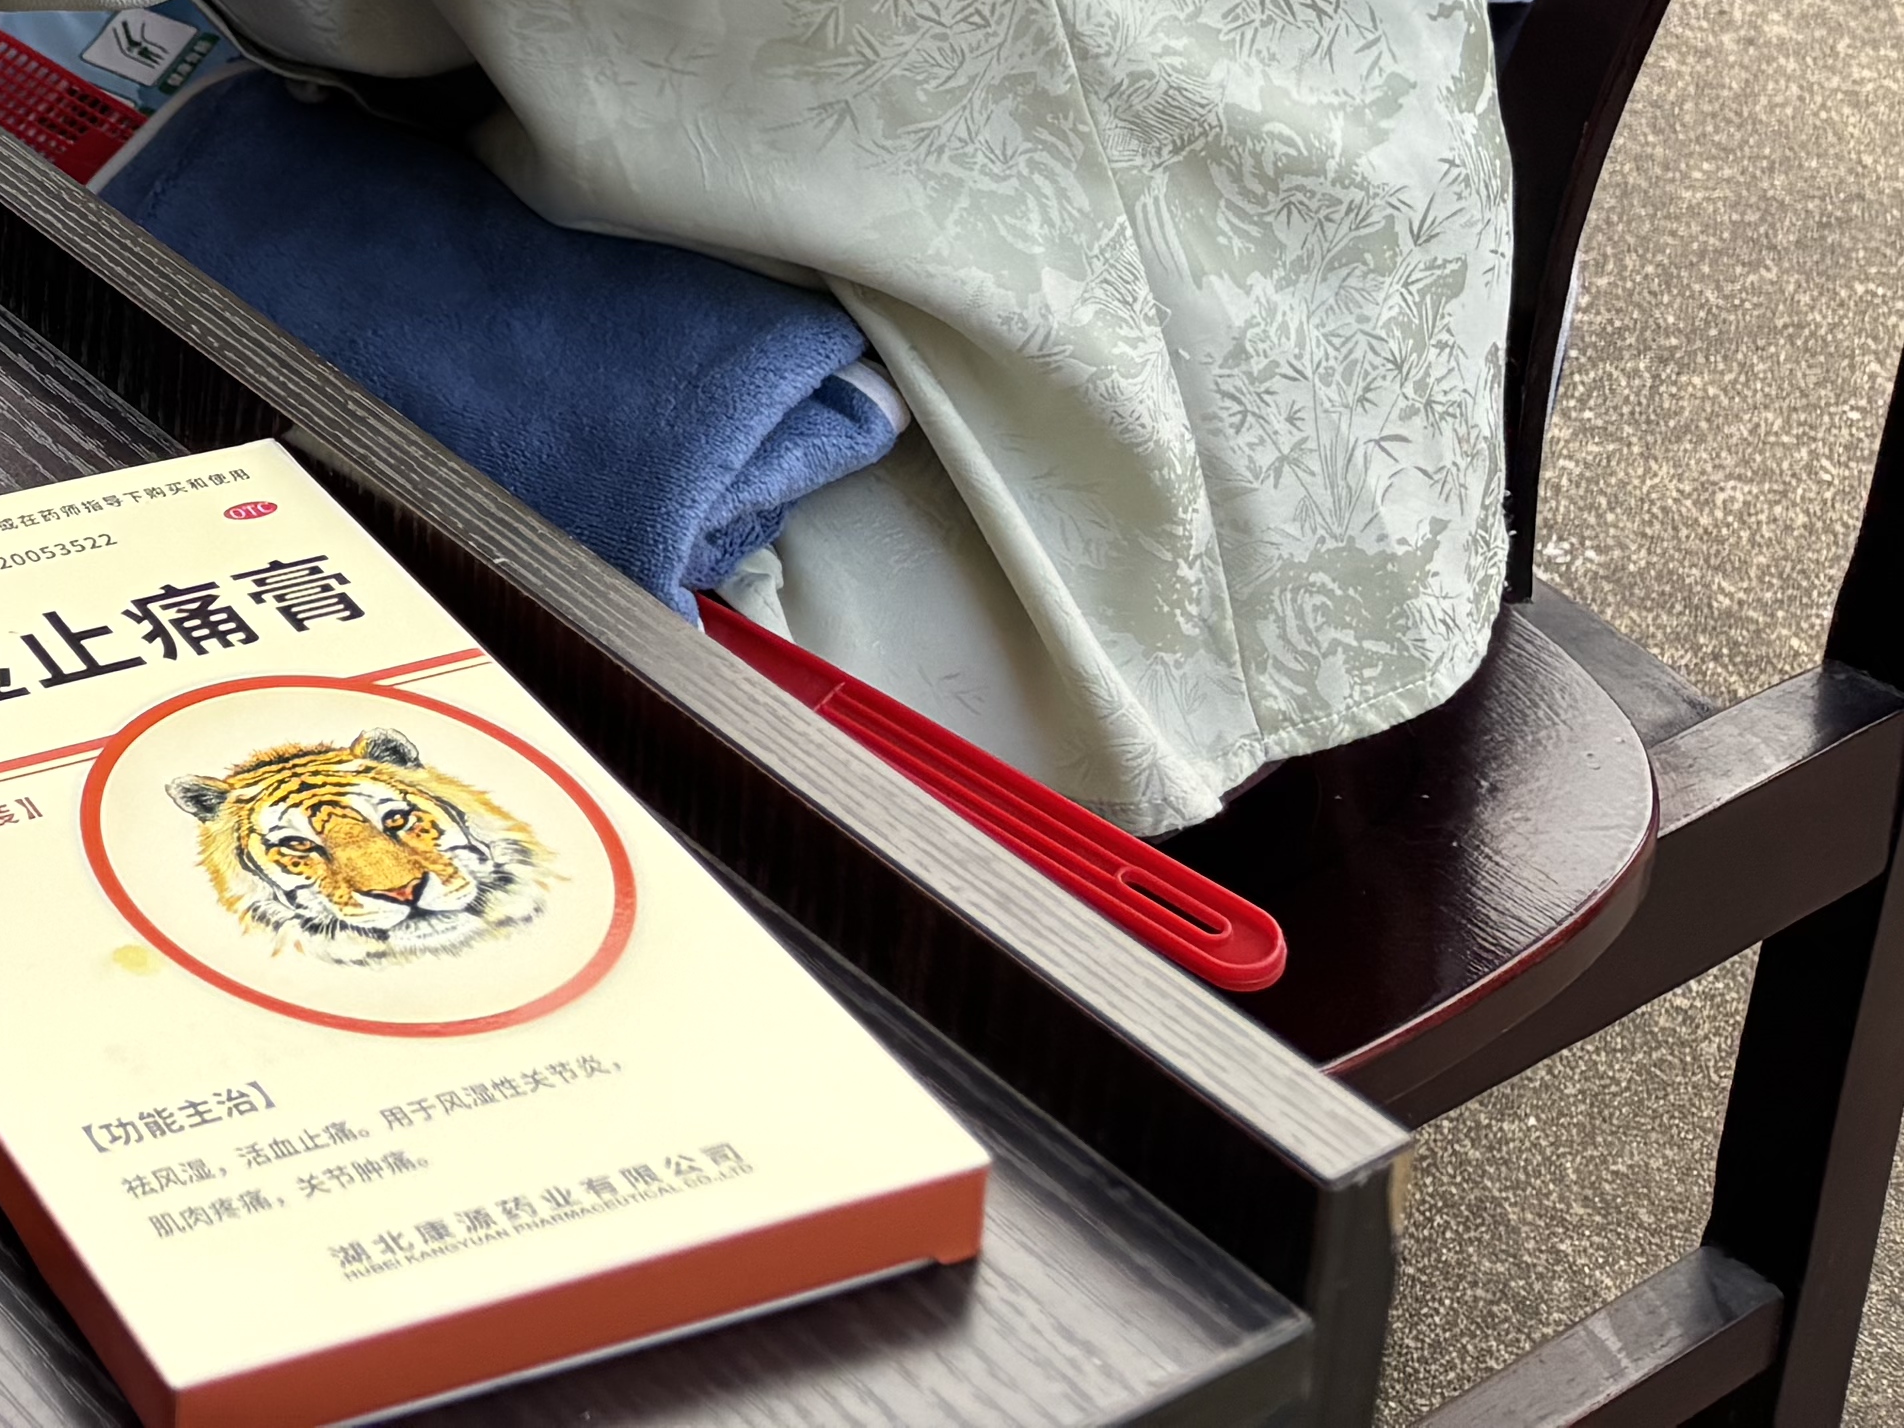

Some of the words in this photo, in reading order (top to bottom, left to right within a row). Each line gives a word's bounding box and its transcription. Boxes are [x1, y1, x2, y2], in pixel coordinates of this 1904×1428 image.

[226, 502, 276, 521] OTC
[81, 1080, 277, 1154] 【功能主治】
[147, 1147, 431, 1240] 肌肉疼痛,关节肿痛。
[328, 1141, 748, 1270] 湖北康源药业有限公司
[343, 1257, 405, 1283] HUBEI
[405, 1229, 512, 1269] KANGYUAN
[512, 1184, 685, 1237] PHARMACEUTICAL
